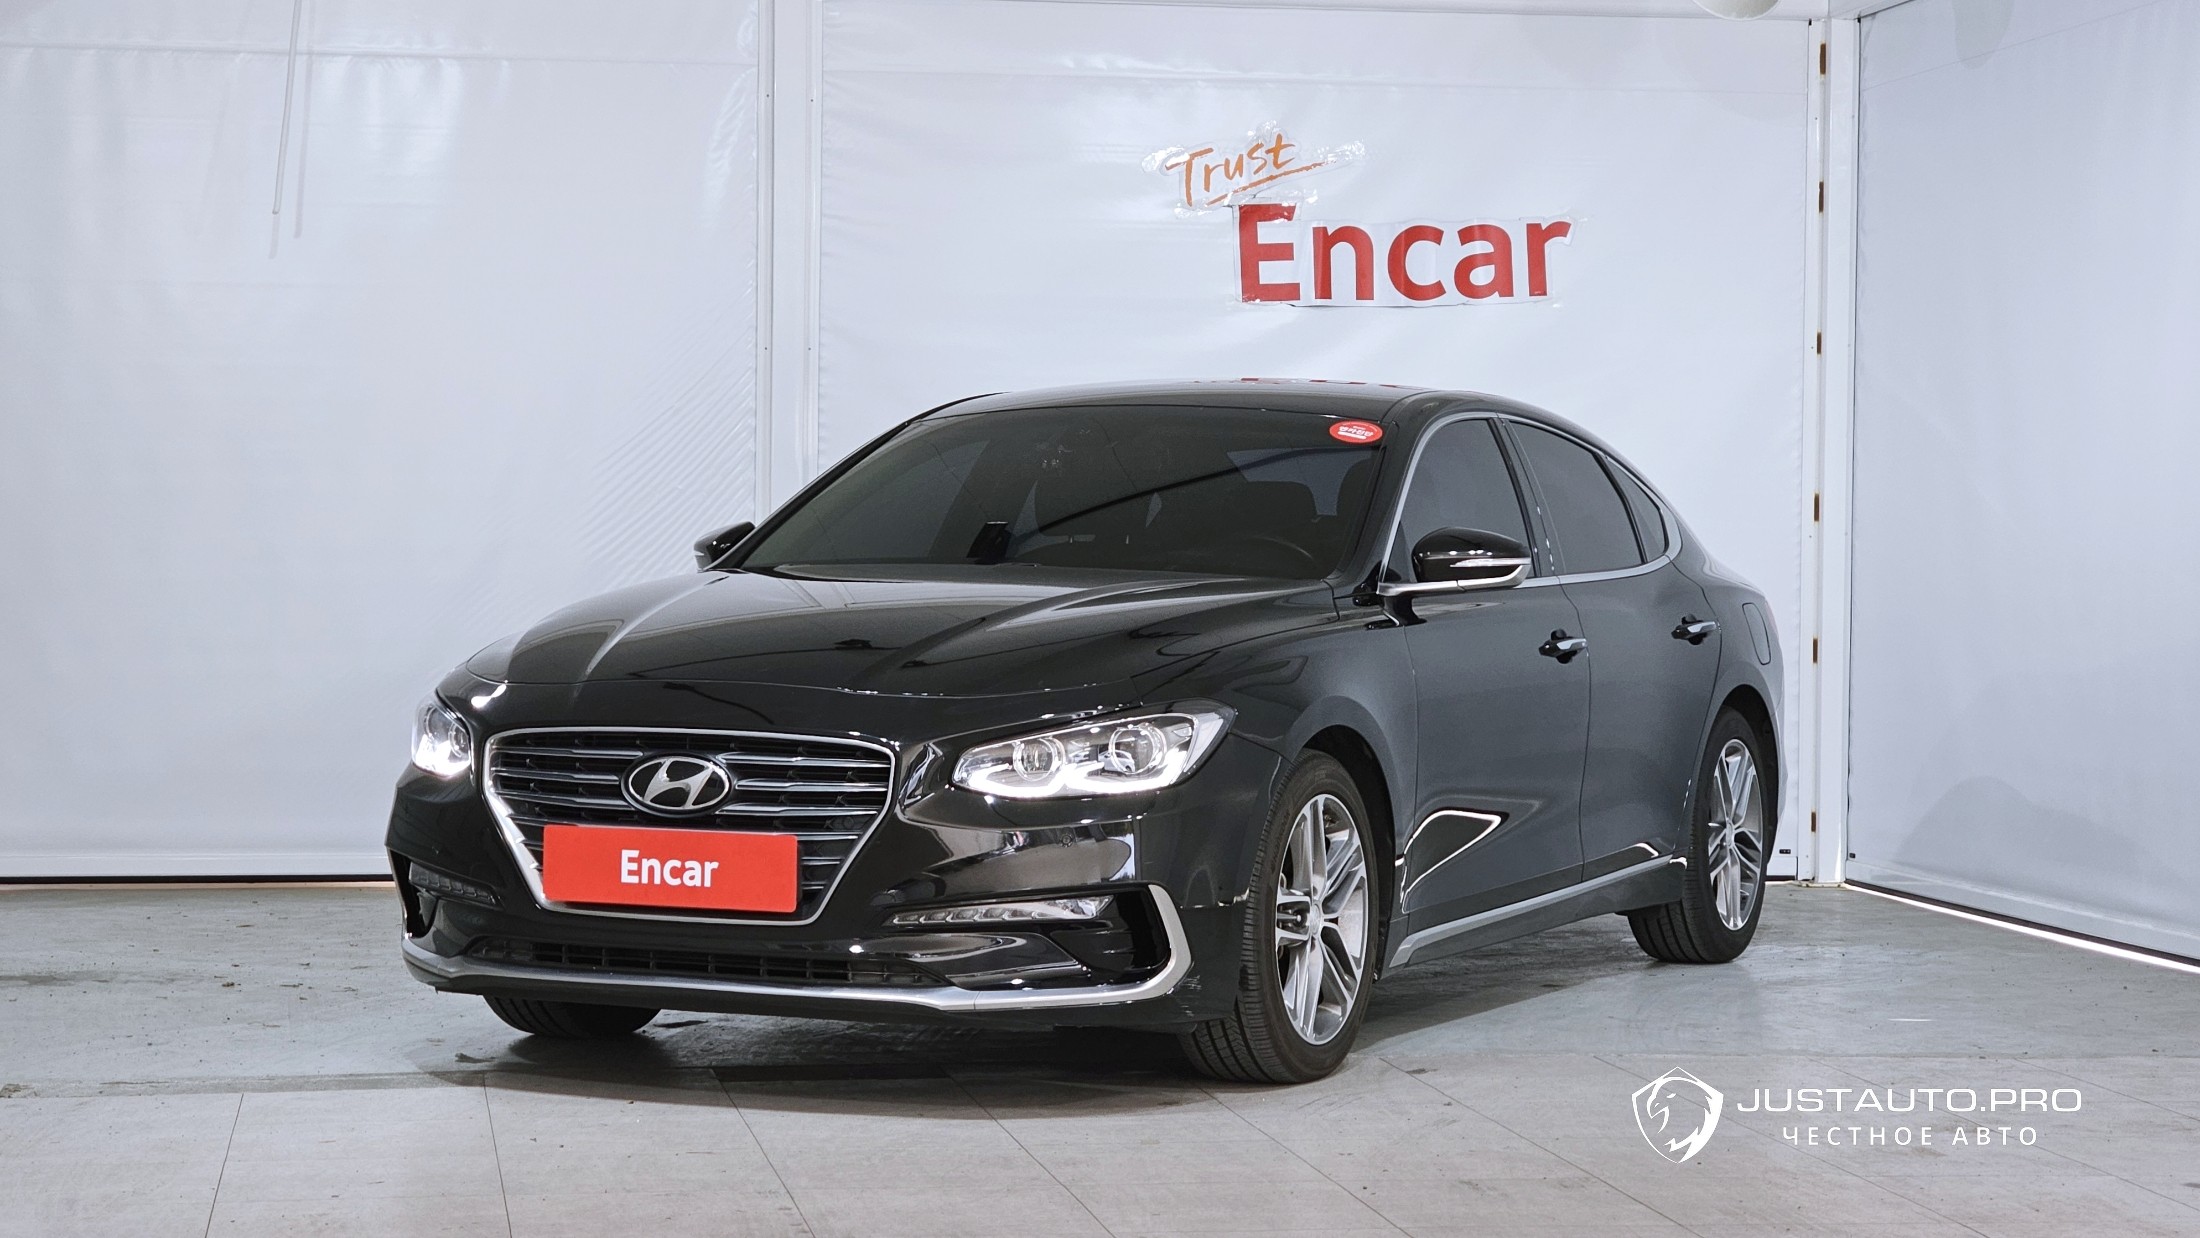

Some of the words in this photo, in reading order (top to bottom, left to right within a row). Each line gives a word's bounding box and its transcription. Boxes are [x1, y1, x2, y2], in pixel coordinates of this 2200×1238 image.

[1165, 133, 1295, 206] Trust
[1239, 203, 1571, 302] Encar
[620, 849, 719, 888] Encar
